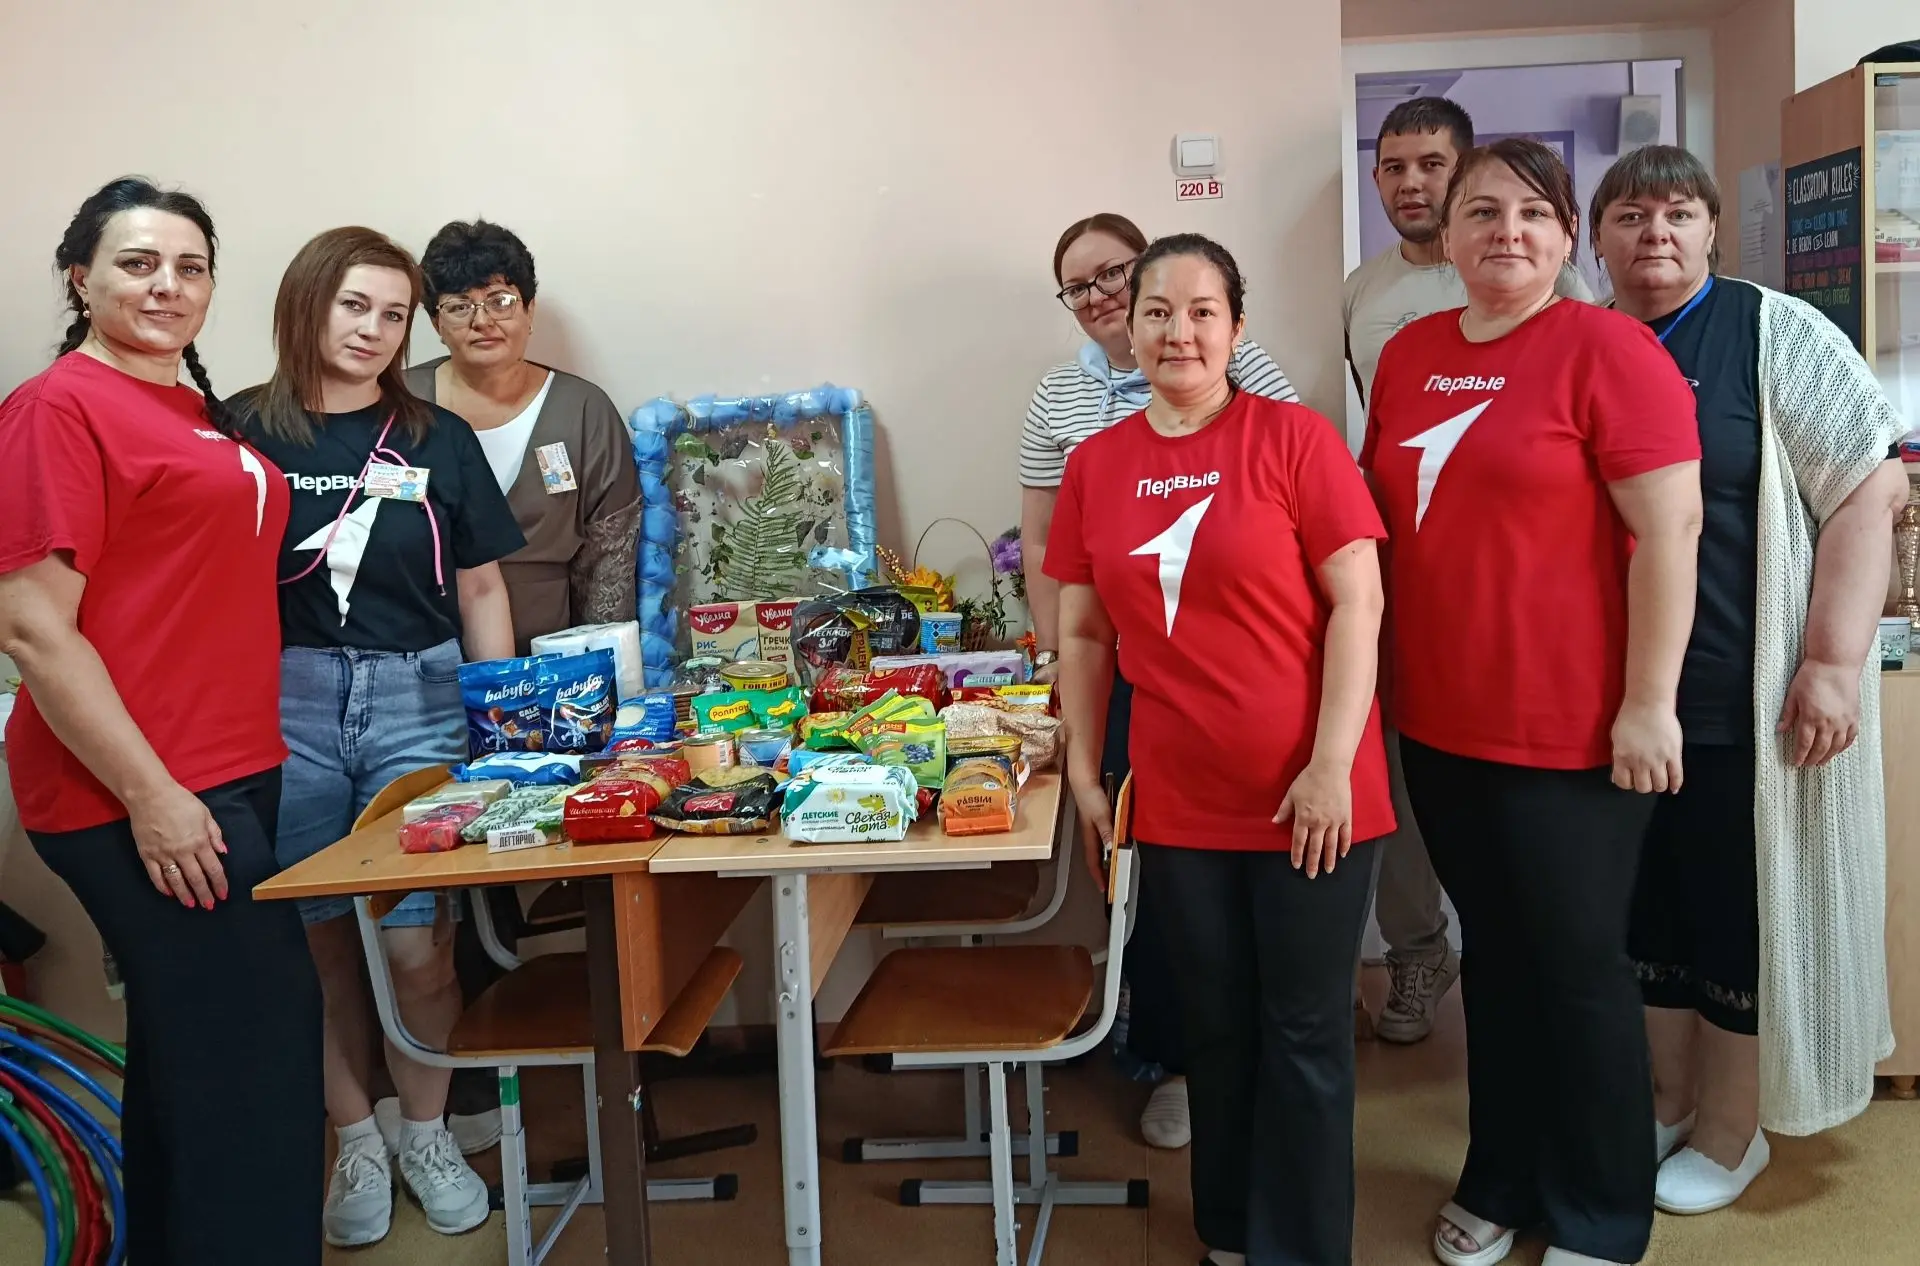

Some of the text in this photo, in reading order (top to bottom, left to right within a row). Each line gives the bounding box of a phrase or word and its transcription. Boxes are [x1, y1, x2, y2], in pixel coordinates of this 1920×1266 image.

[1180, 182, 1204, 197] 220
[1792, 169, 1829, 206] CLASSROOM
[1831, 161, 1853, 196] RULES
[1824, 229, 1839, 248] LEARN
[1424, 373, 1506, 396] Первые
[284, 473, 366, 496] Первы
[1136, 470, 1220, 499] Первые
[696, 640, 717, 650] РИС
[763, 636, 791, 646] ГРЕЧК
[801, 811, 839, 820] ДЕТСКИЕ
[845, 811, 891, 825] Свежая
